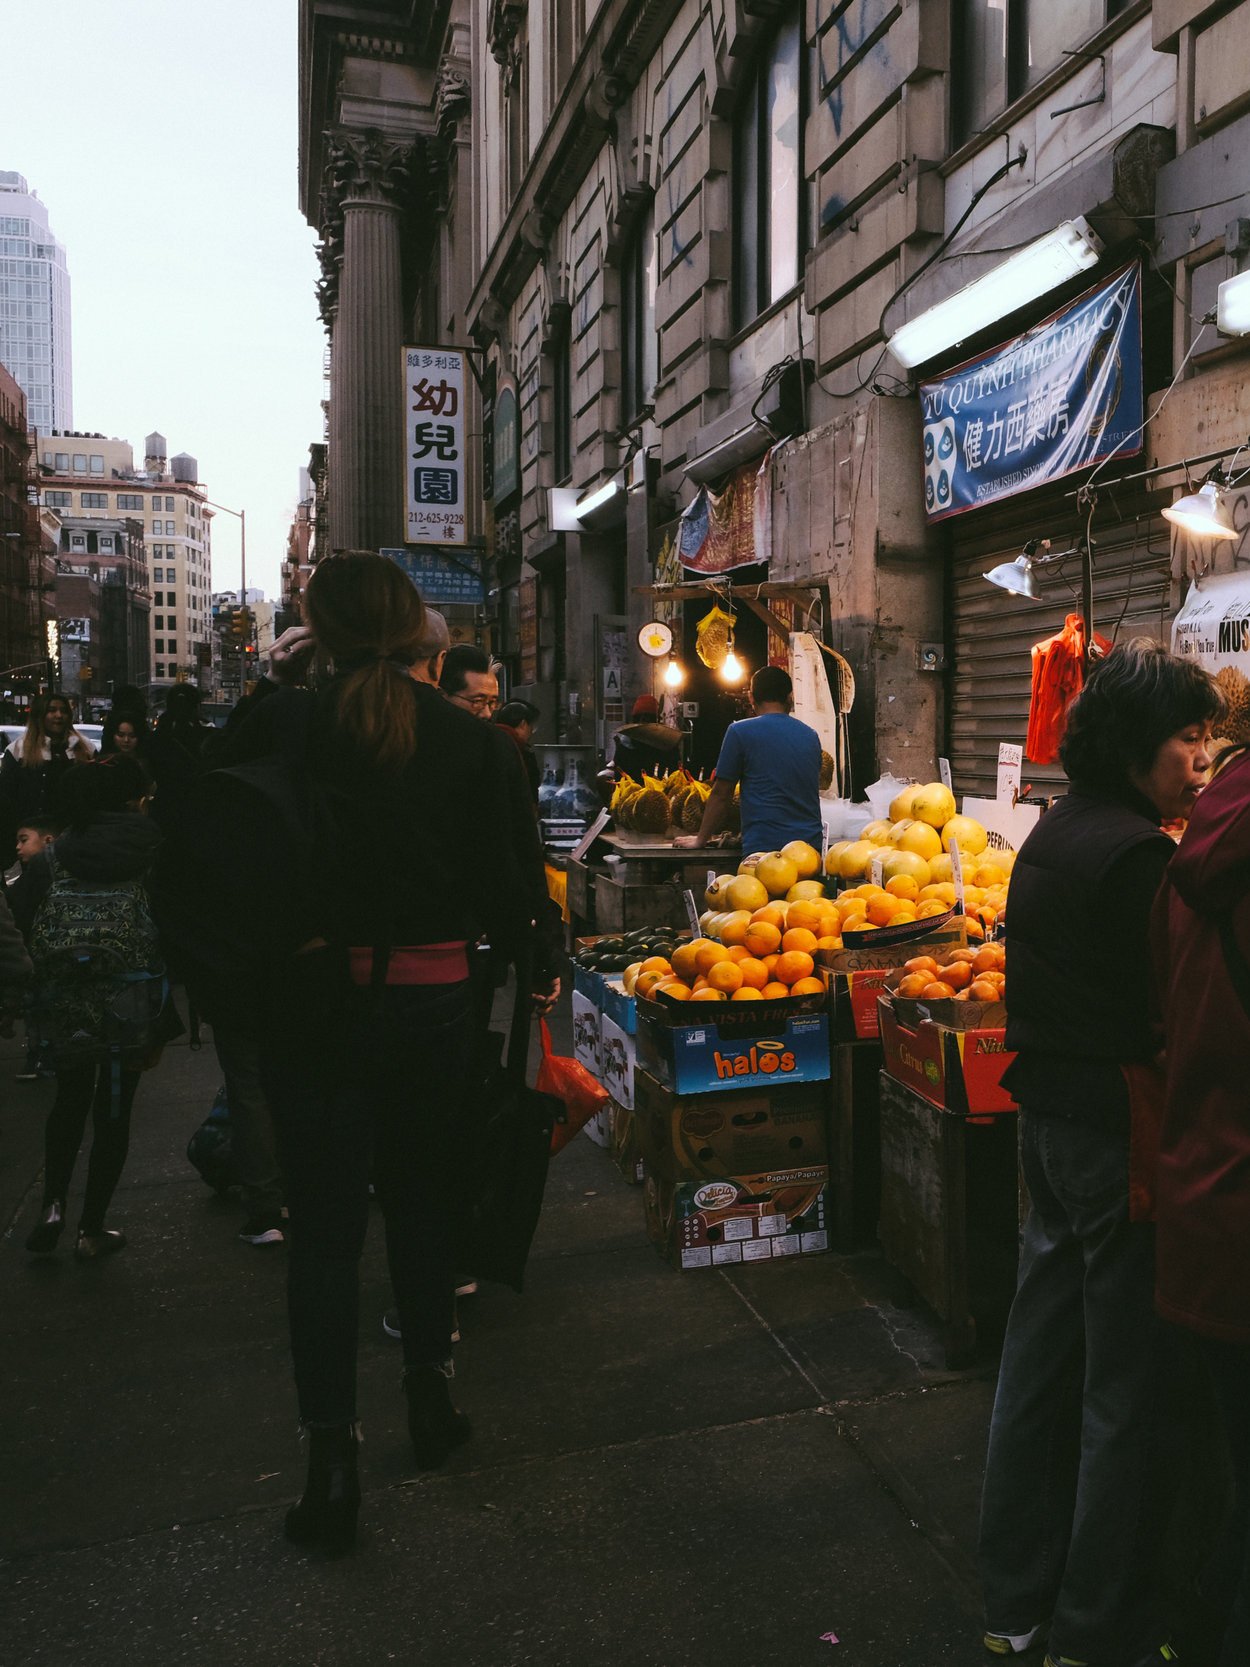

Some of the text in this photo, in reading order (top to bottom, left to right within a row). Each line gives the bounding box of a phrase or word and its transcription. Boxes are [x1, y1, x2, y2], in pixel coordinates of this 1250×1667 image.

[1020, 285, 1132, 380] PHARMACY
[407, 353, 462, 371] 維多利亞
[411, 377, 459, 506] 幼兒園
[962, 377, 1070, 474] 健力西藥房
[976, 466, 1023, 498] ESTABLISHED
[408, 511, 465, 526] 212-625-9228
[606, 671, 618, 689] A
[713, 1045, 797, 1080] halos
[766, 1170, 825, 1184] Papaya/Papaye
